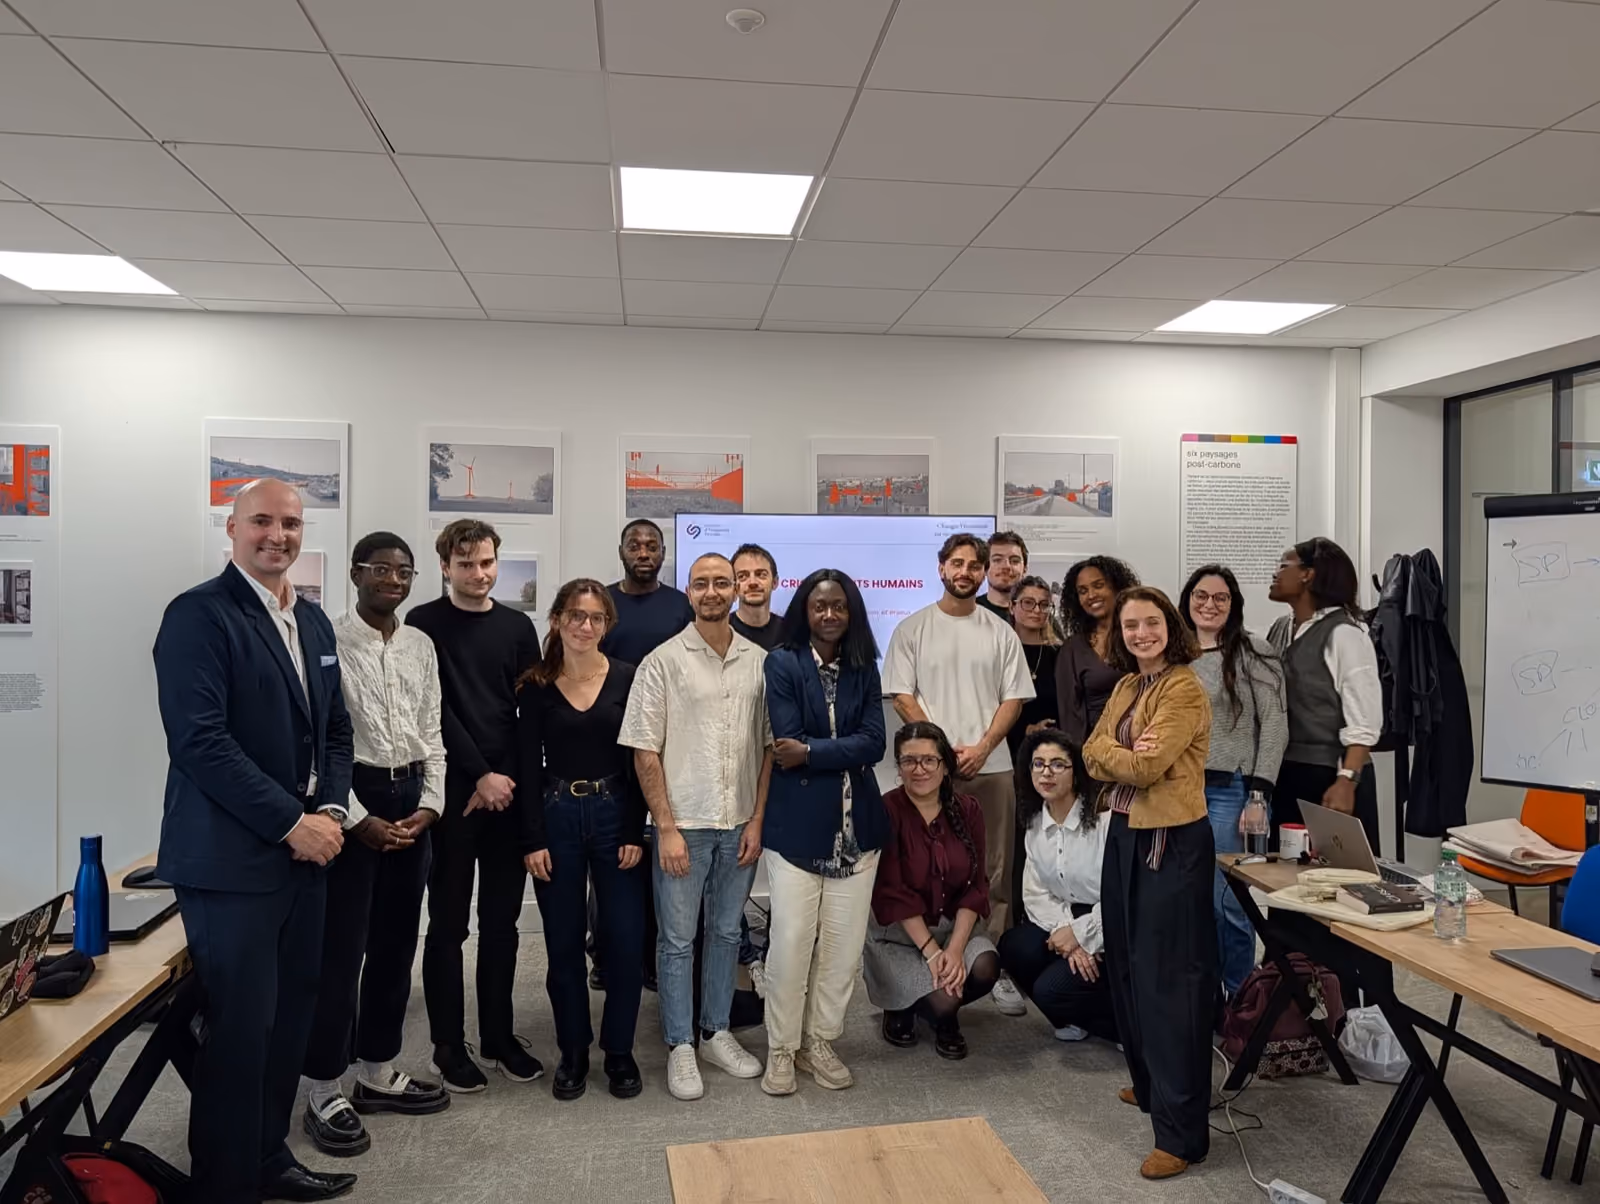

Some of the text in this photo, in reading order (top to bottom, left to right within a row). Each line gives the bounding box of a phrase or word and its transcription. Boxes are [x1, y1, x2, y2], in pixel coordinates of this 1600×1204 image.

[1187, 450, 1238, 460] six paysages
[1187, 461, 1241, 469] post-carbone
[872, 580, 924, 589] HUMAINS
